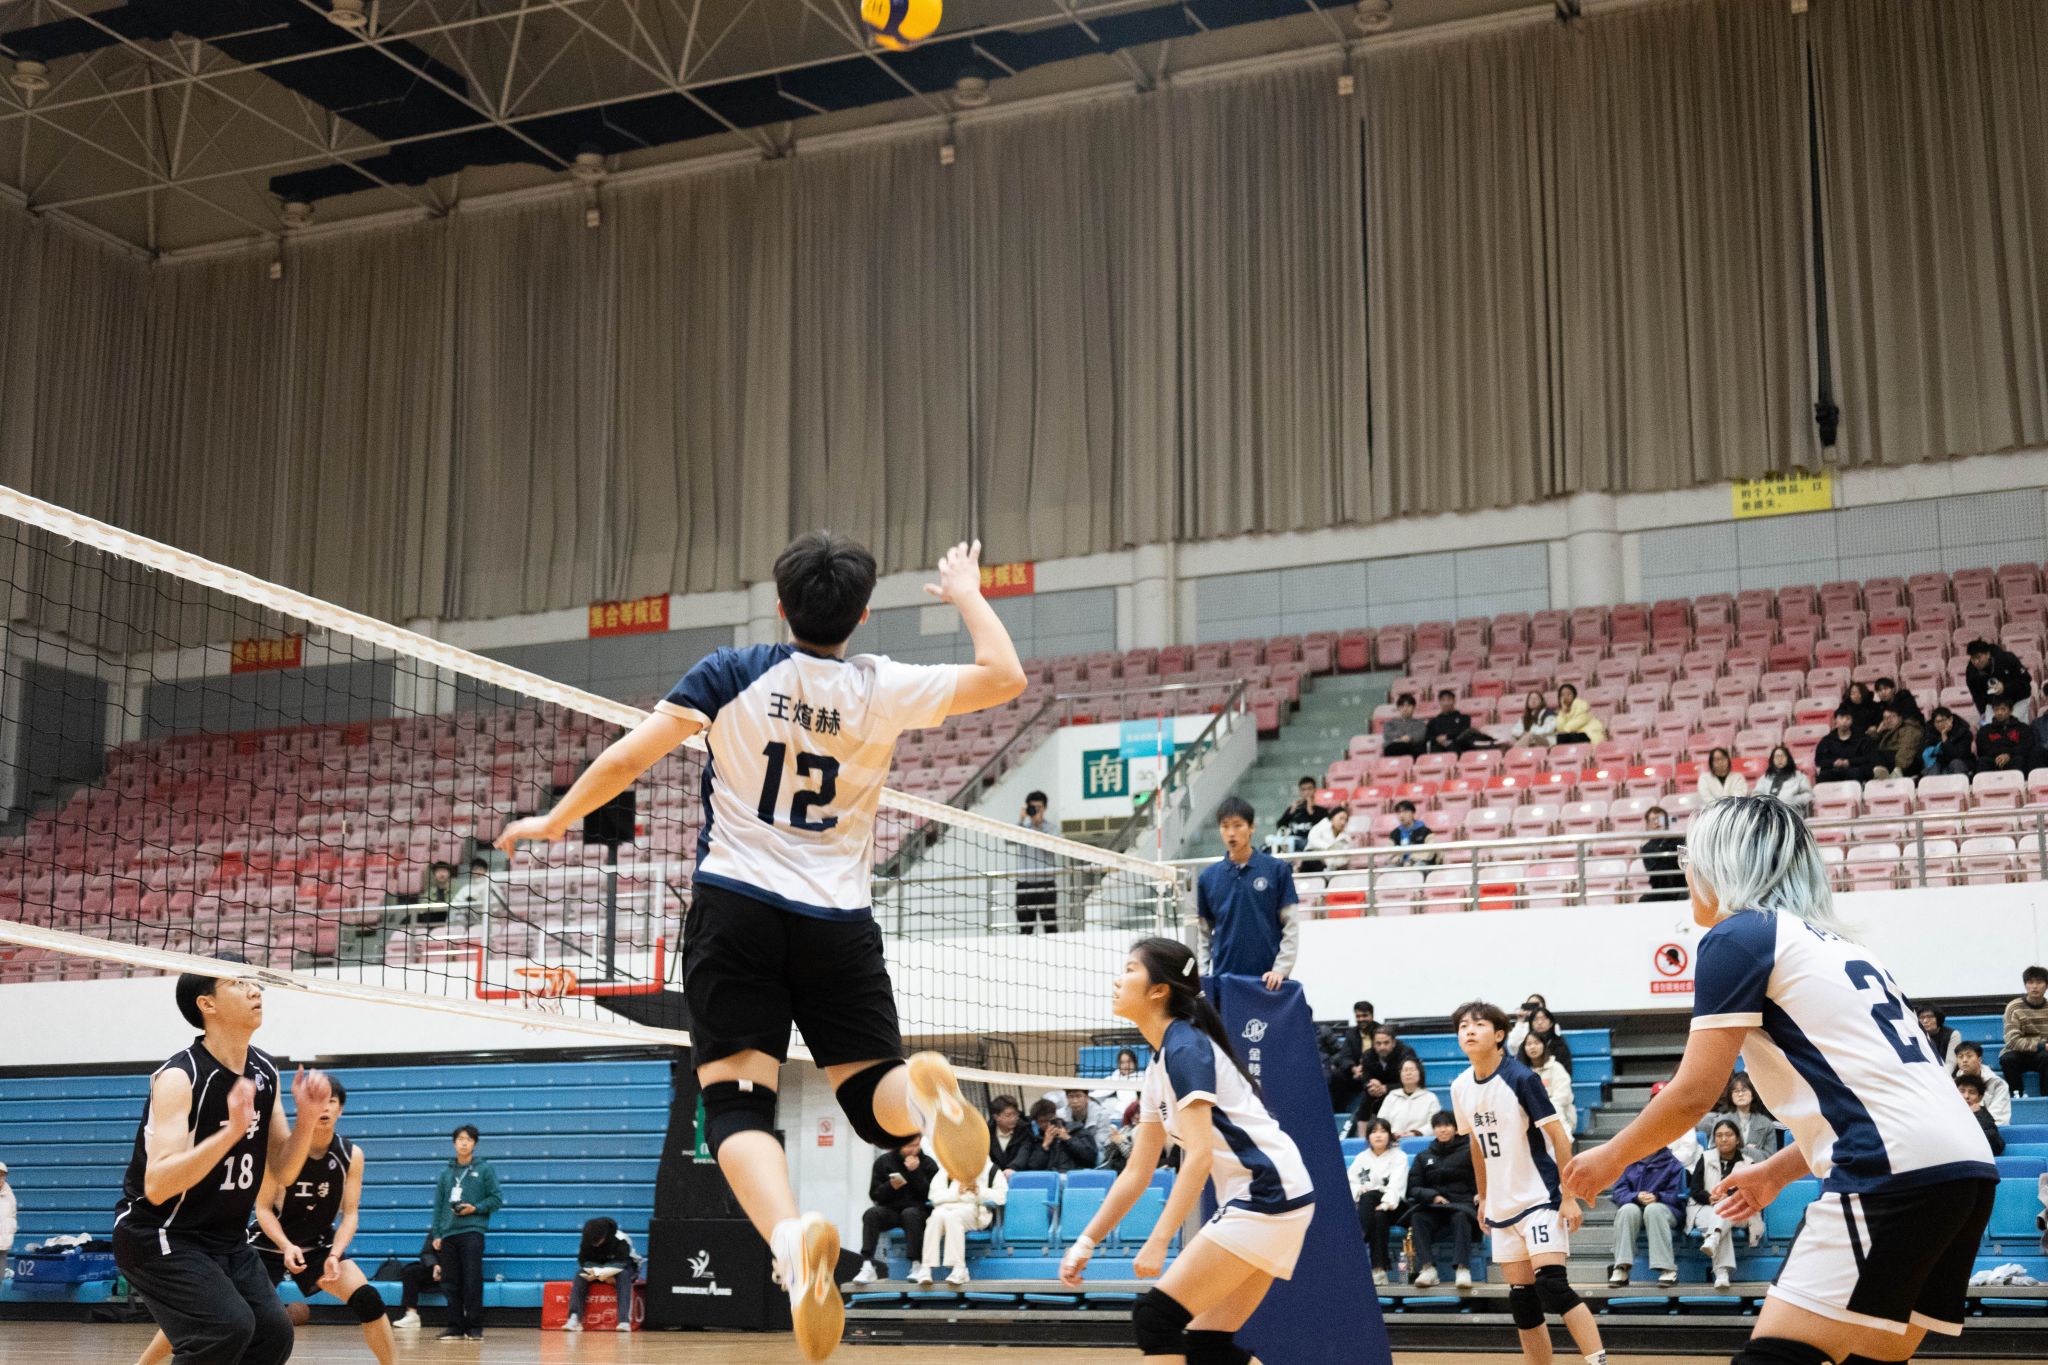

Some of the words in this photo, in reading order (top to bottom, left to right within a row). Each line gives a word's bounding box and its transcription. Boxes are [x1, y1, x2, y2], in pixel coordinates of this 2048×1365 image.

[757, 741, 840, 832] 12
[1088, 754, 1122, 794] 南
[1844, 960, 1944, 1066] 2
[1248, 1048, 1261, 1090] 金陵
[1474, 1111, 1497, 1127] 食科
[1479, 1133, 1501, 1159] 15
[220, 1153, 254, 1190] 18
[295, 1182, 329, 1198] 工学
[1532, 1225, 1549, 1244] 15
